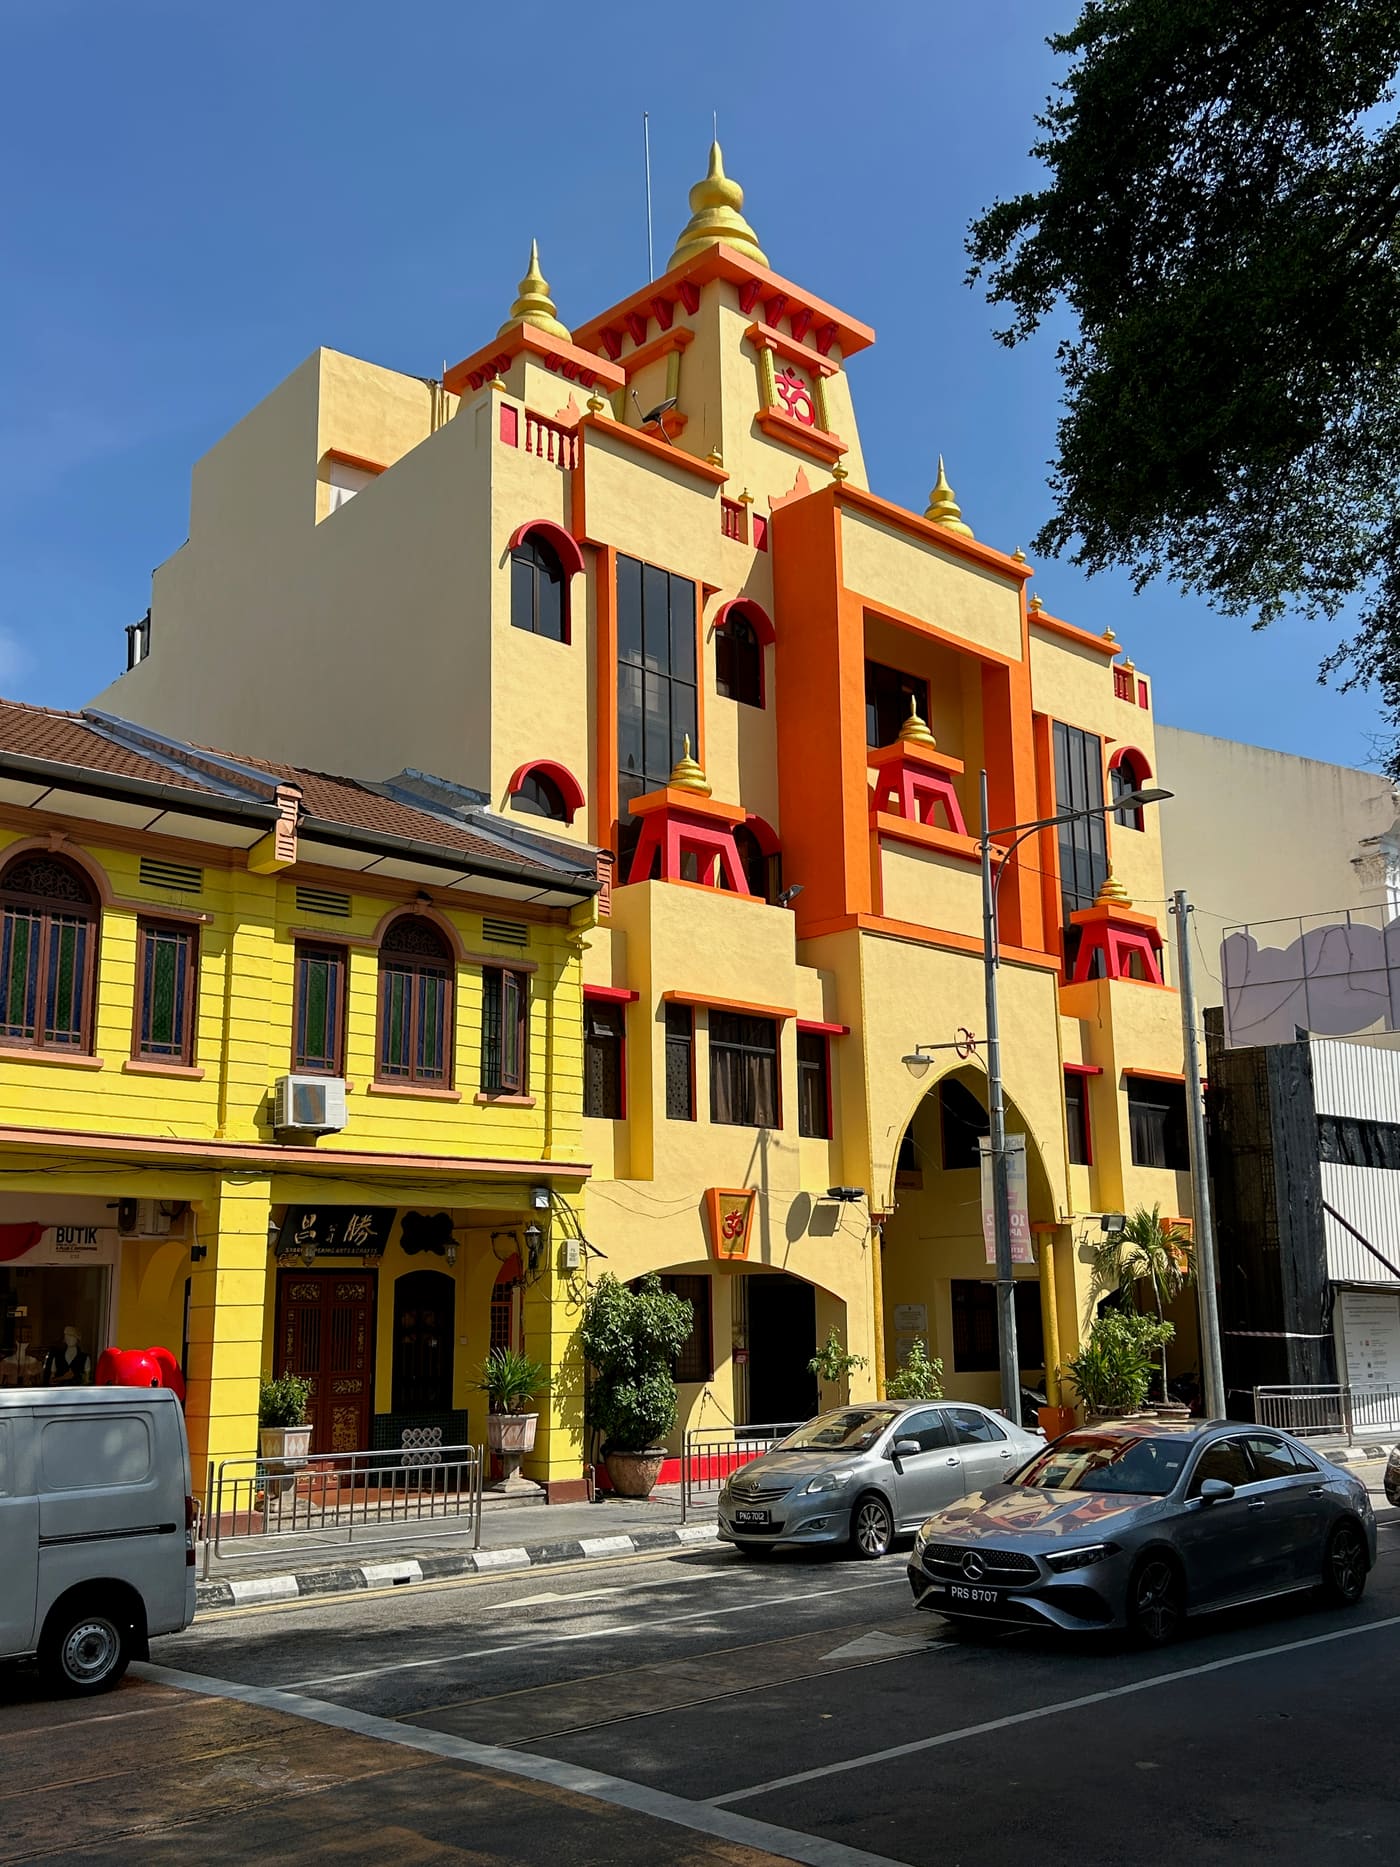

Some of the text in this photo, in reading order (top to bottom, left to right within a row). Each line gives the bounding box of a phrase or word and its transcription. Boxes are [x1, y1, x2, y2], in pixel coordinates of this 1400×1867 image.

[56, 1226, 97, 1244] BUTIK
[951, 1586, 998, 1603] PRS 8707
